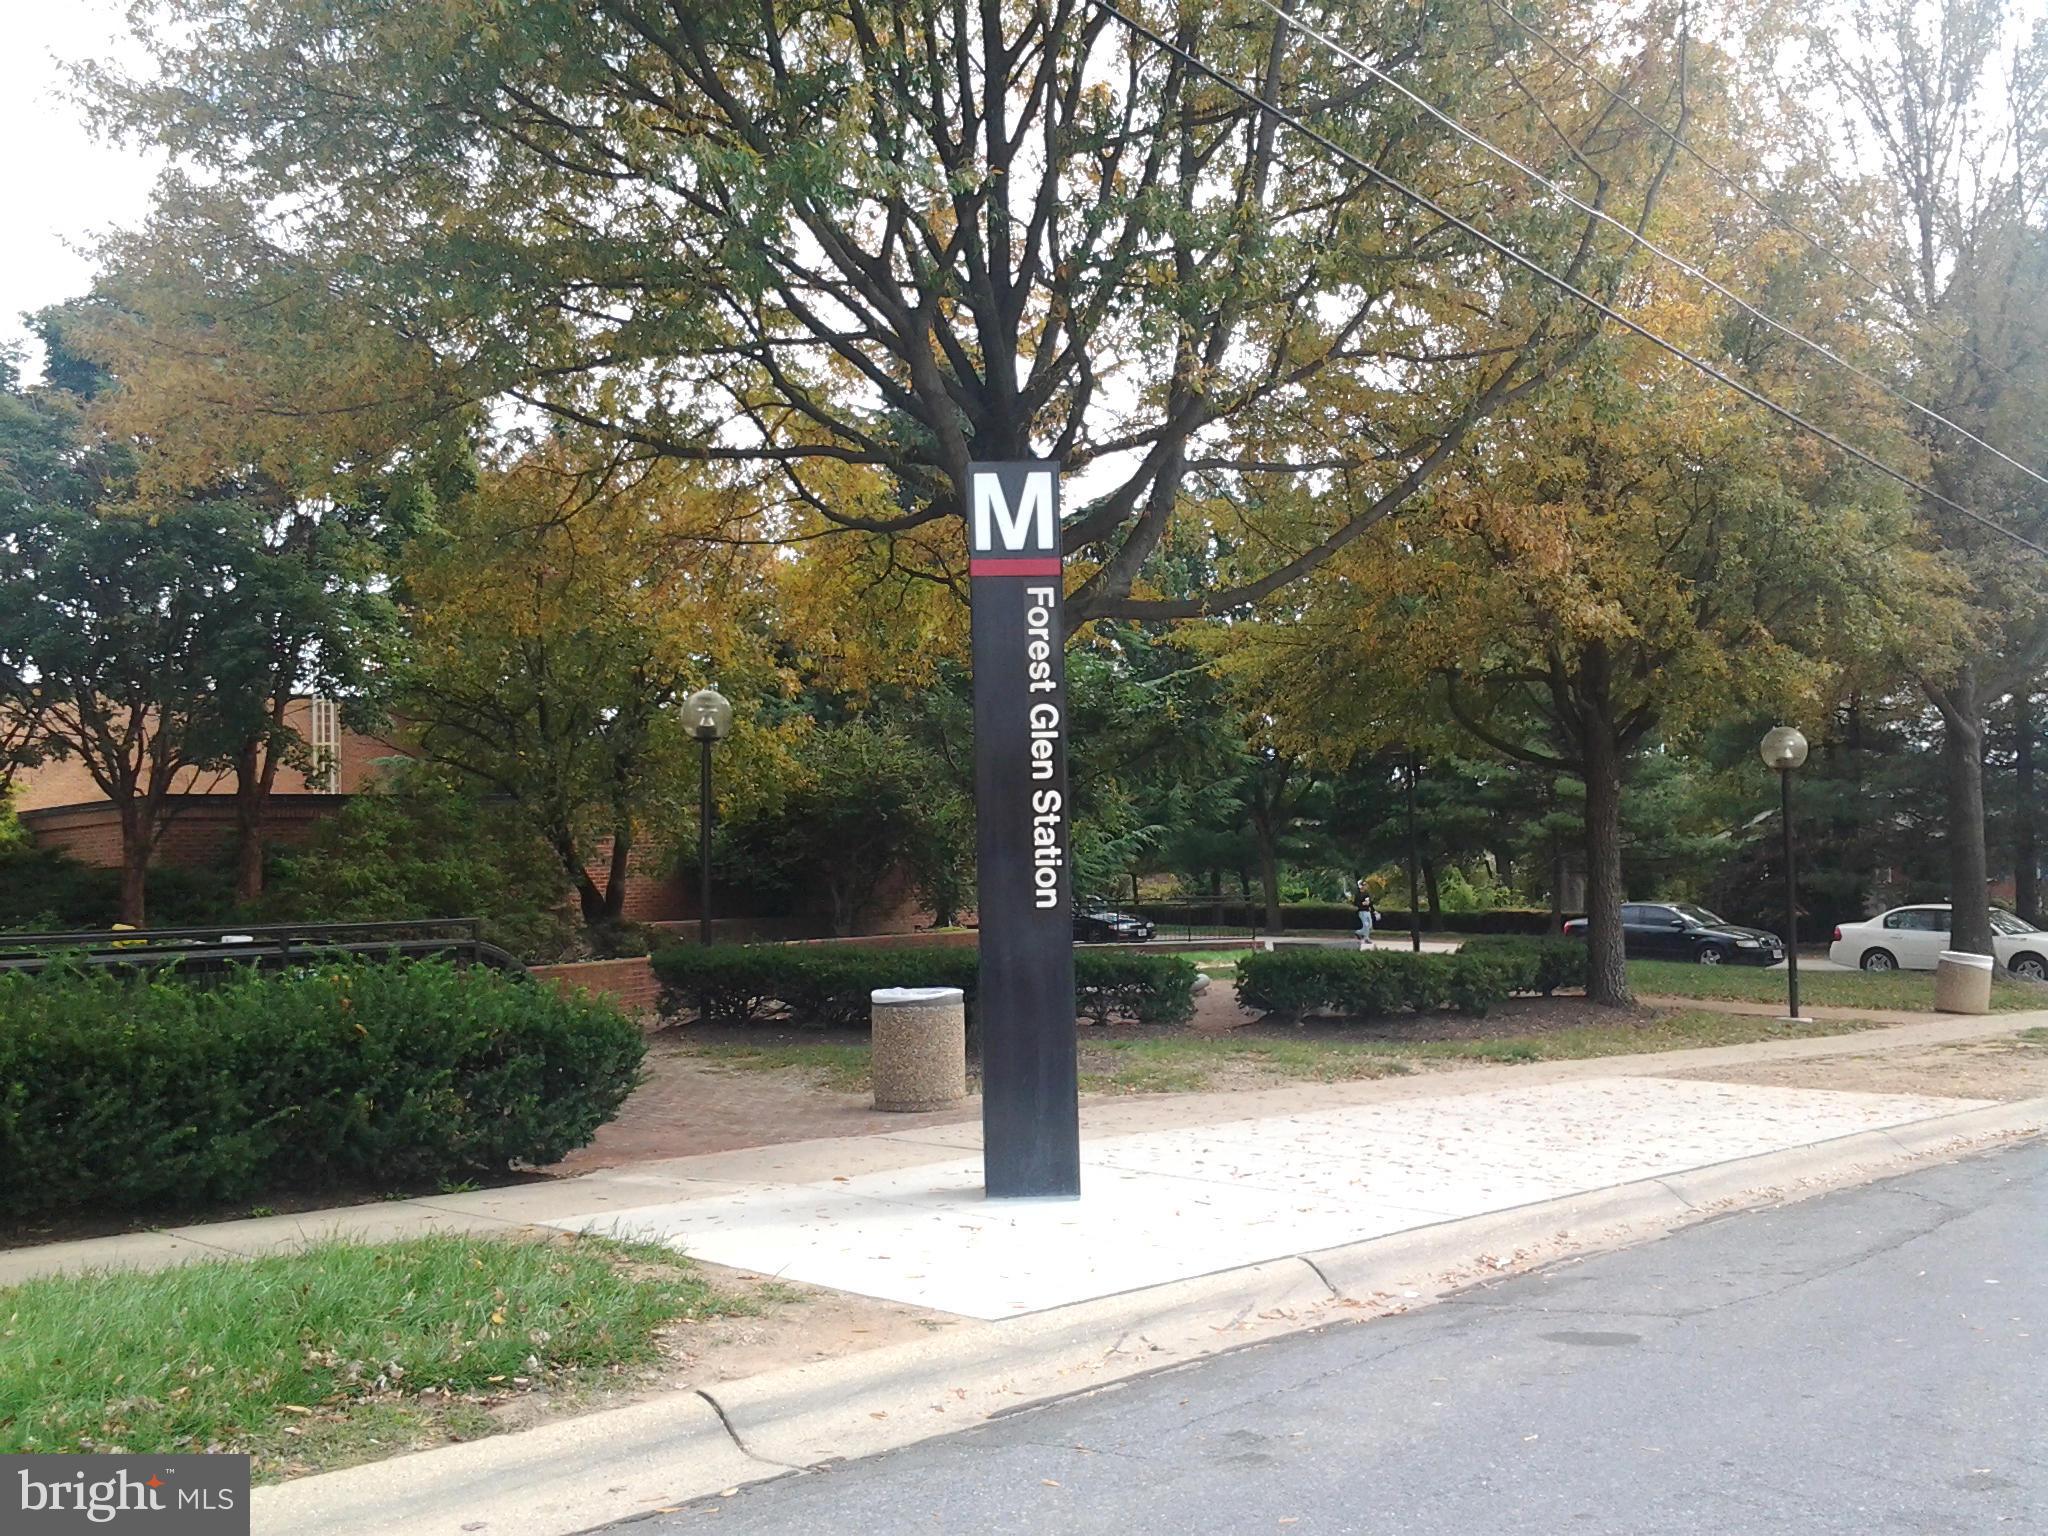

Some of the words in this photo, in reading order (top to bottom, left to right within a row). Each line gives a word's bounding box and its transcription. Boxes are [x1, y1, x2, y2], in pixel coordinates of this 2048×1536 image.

[973, 471, 1054, 551] M
[1026, 586, 1057, 693] Forest
[1029, 703, 1060, 780] Glen
[1032, 789, 1063, 909] Station
